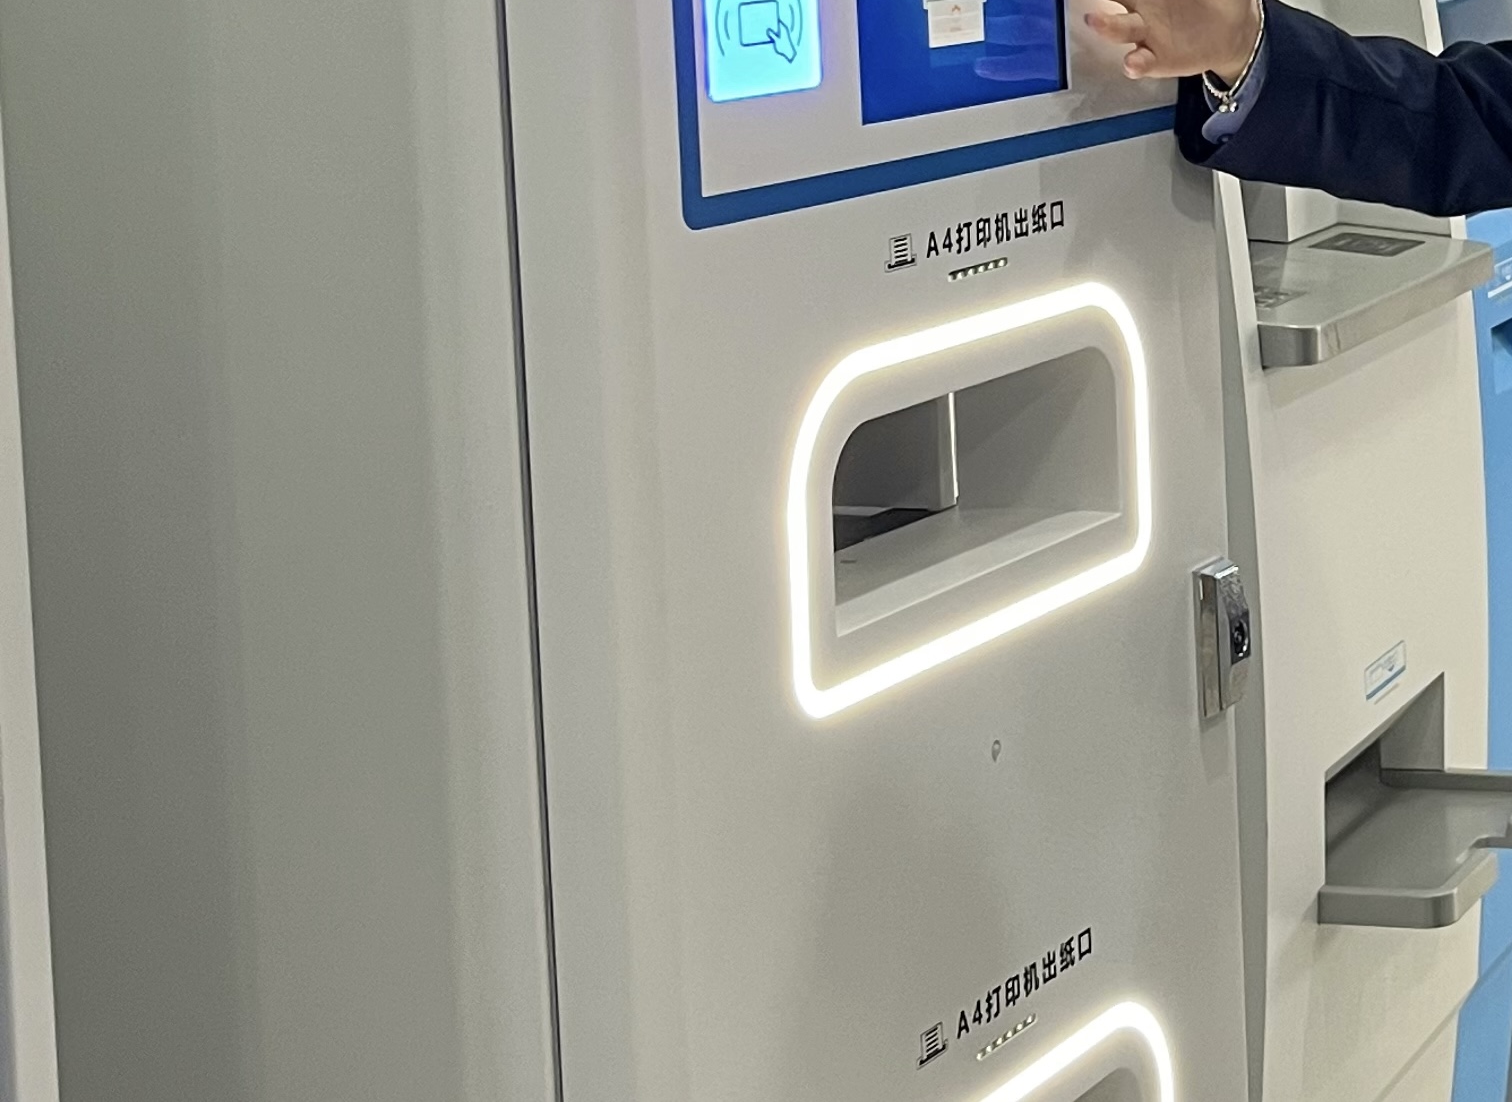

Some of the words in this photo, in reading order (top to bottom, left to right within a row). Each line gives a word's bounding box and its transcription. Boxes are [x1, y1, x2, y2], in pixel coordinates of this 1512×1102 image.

[926, 200, 1065, 259] A4打印机出纸口
[956, 927, 1093, 1039] A4打印机出纸口
